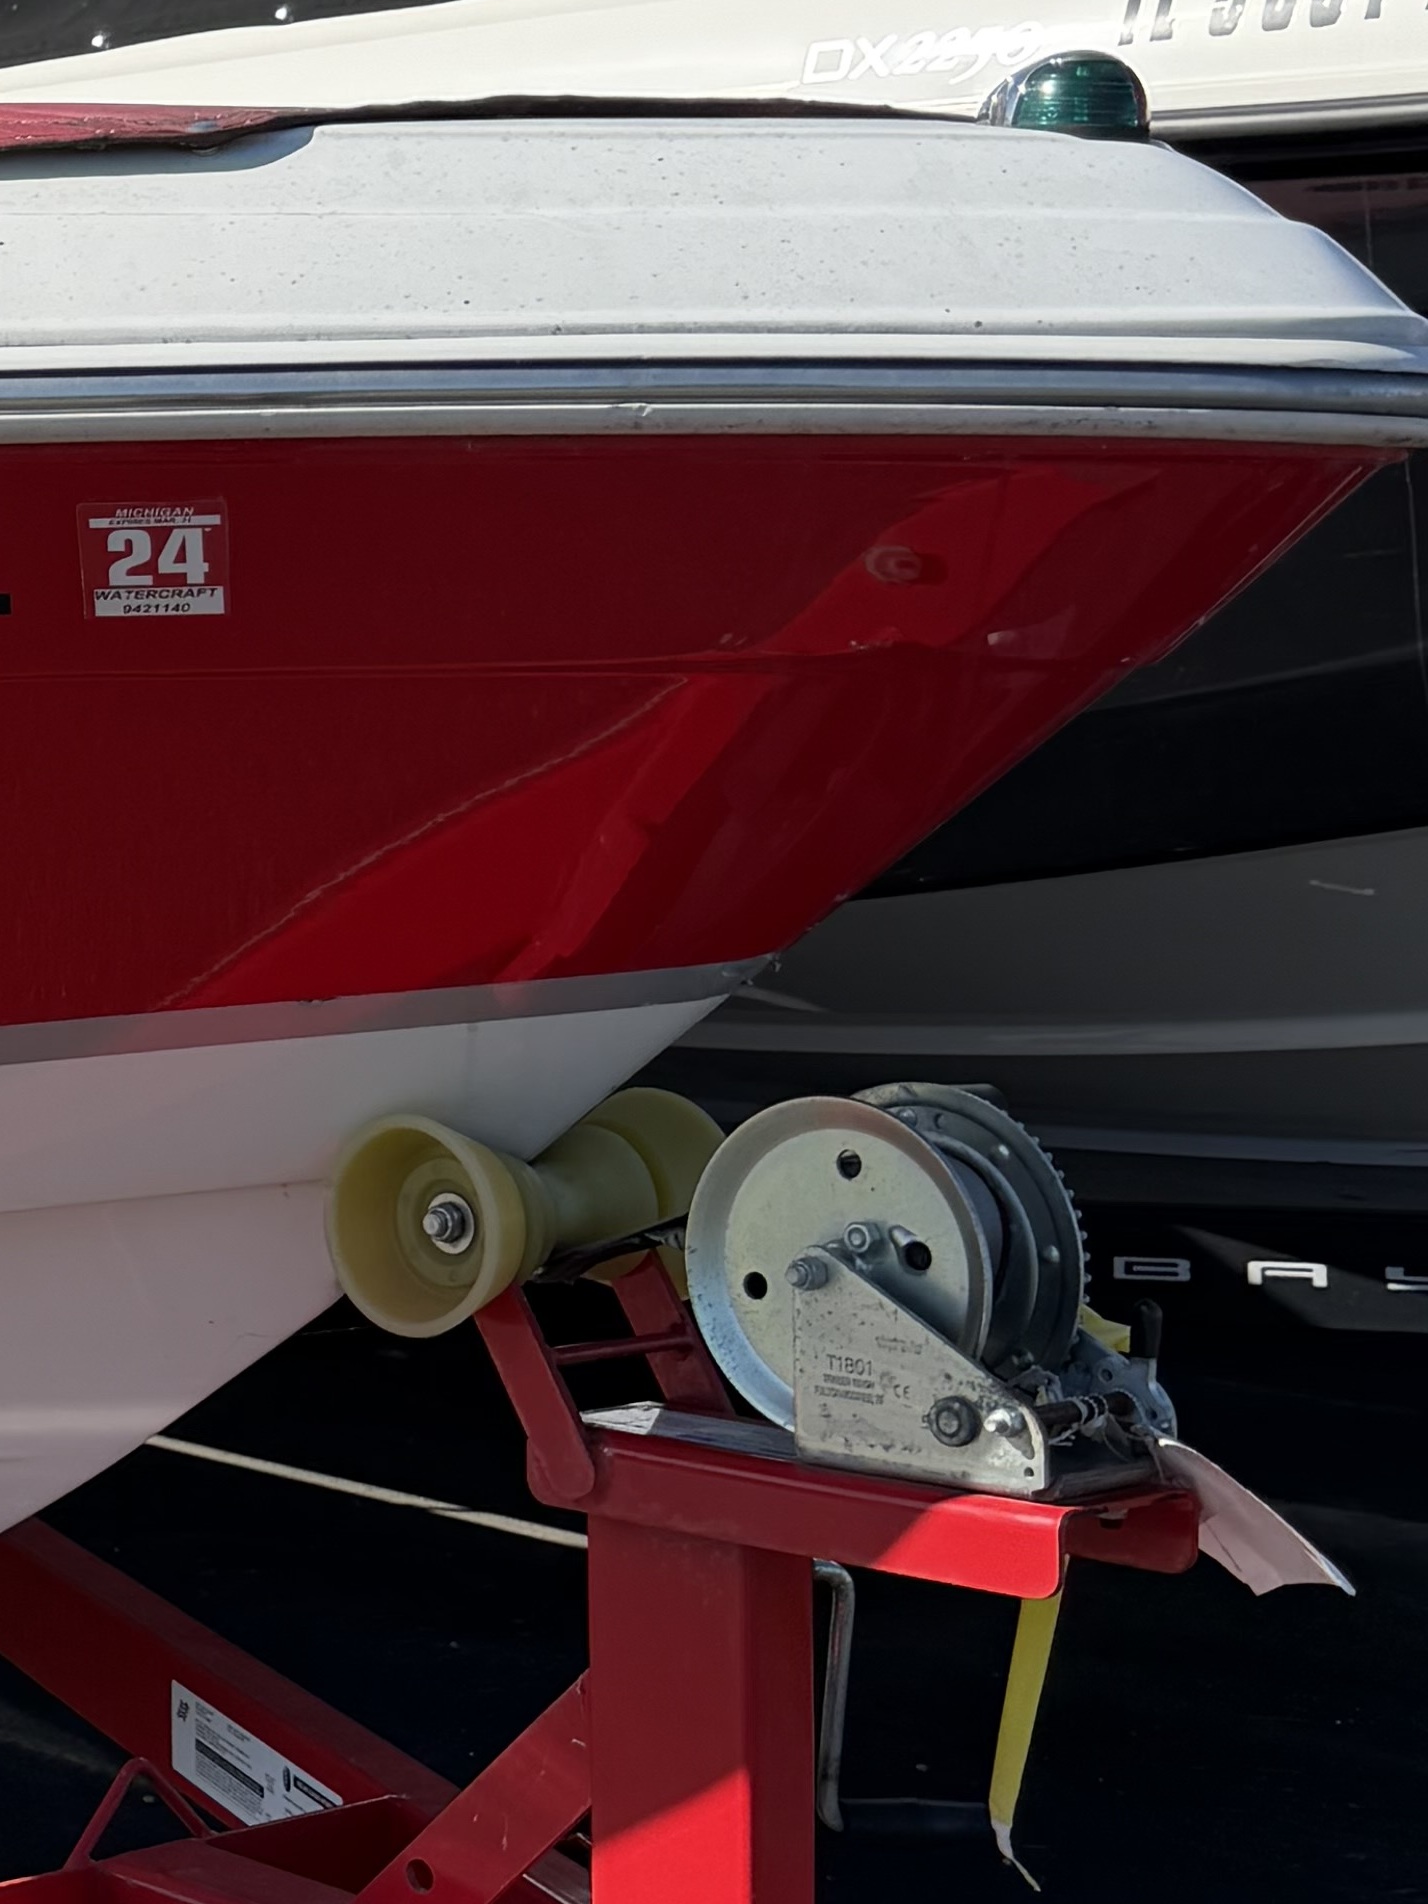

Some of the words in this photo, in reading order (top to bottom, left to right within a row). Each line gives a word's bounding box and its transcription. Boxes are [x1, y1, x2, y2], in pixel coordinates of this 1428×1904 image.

[115, 506, 194, 519] MICHIGAN
[107, 527, 209, 586] 24
[95, 587, 218, 601] WATERCRAFT
[123, 602, 191, 615] 9421140
[826, 1353, 872, 1376] T1801
